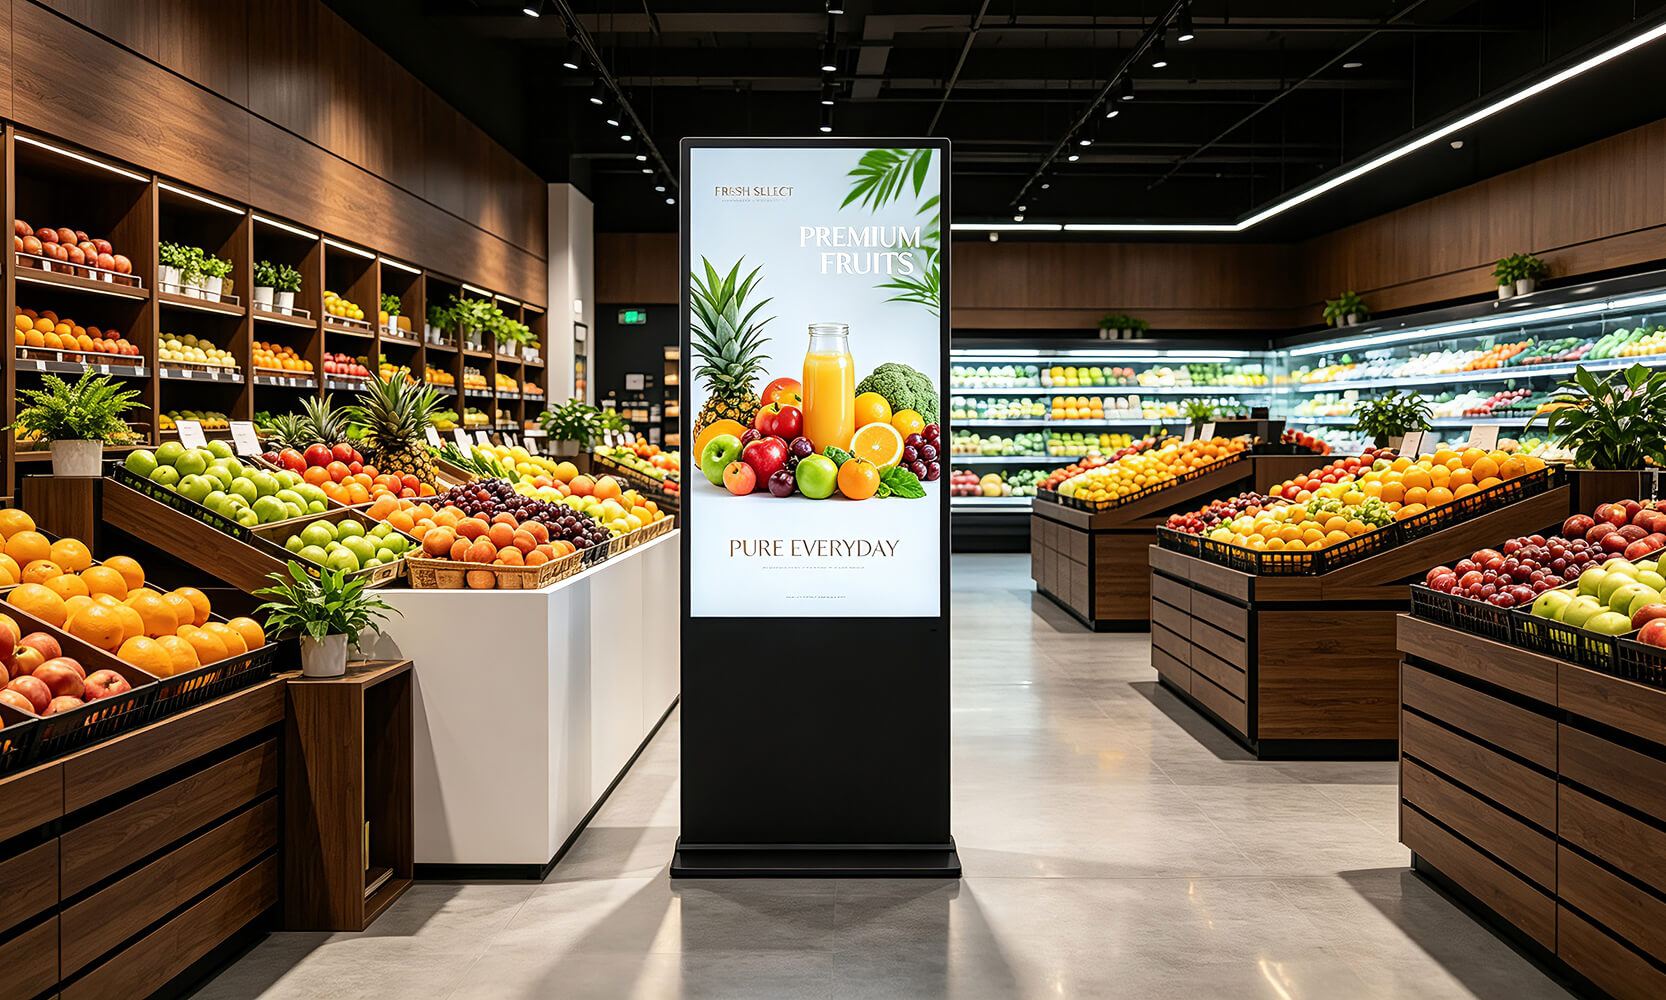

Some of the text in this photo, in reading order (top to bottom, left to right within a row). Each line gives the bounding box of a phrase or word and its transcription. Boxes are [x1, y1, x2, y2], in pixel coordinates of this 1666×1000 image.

[715, 186, 750, 197] FRESH
[800, 226, 921, 248] PREMIUM
[820, 252, 914, 275] FRUITS
[730, 539, 900, 557] PURE EVERYDAY
